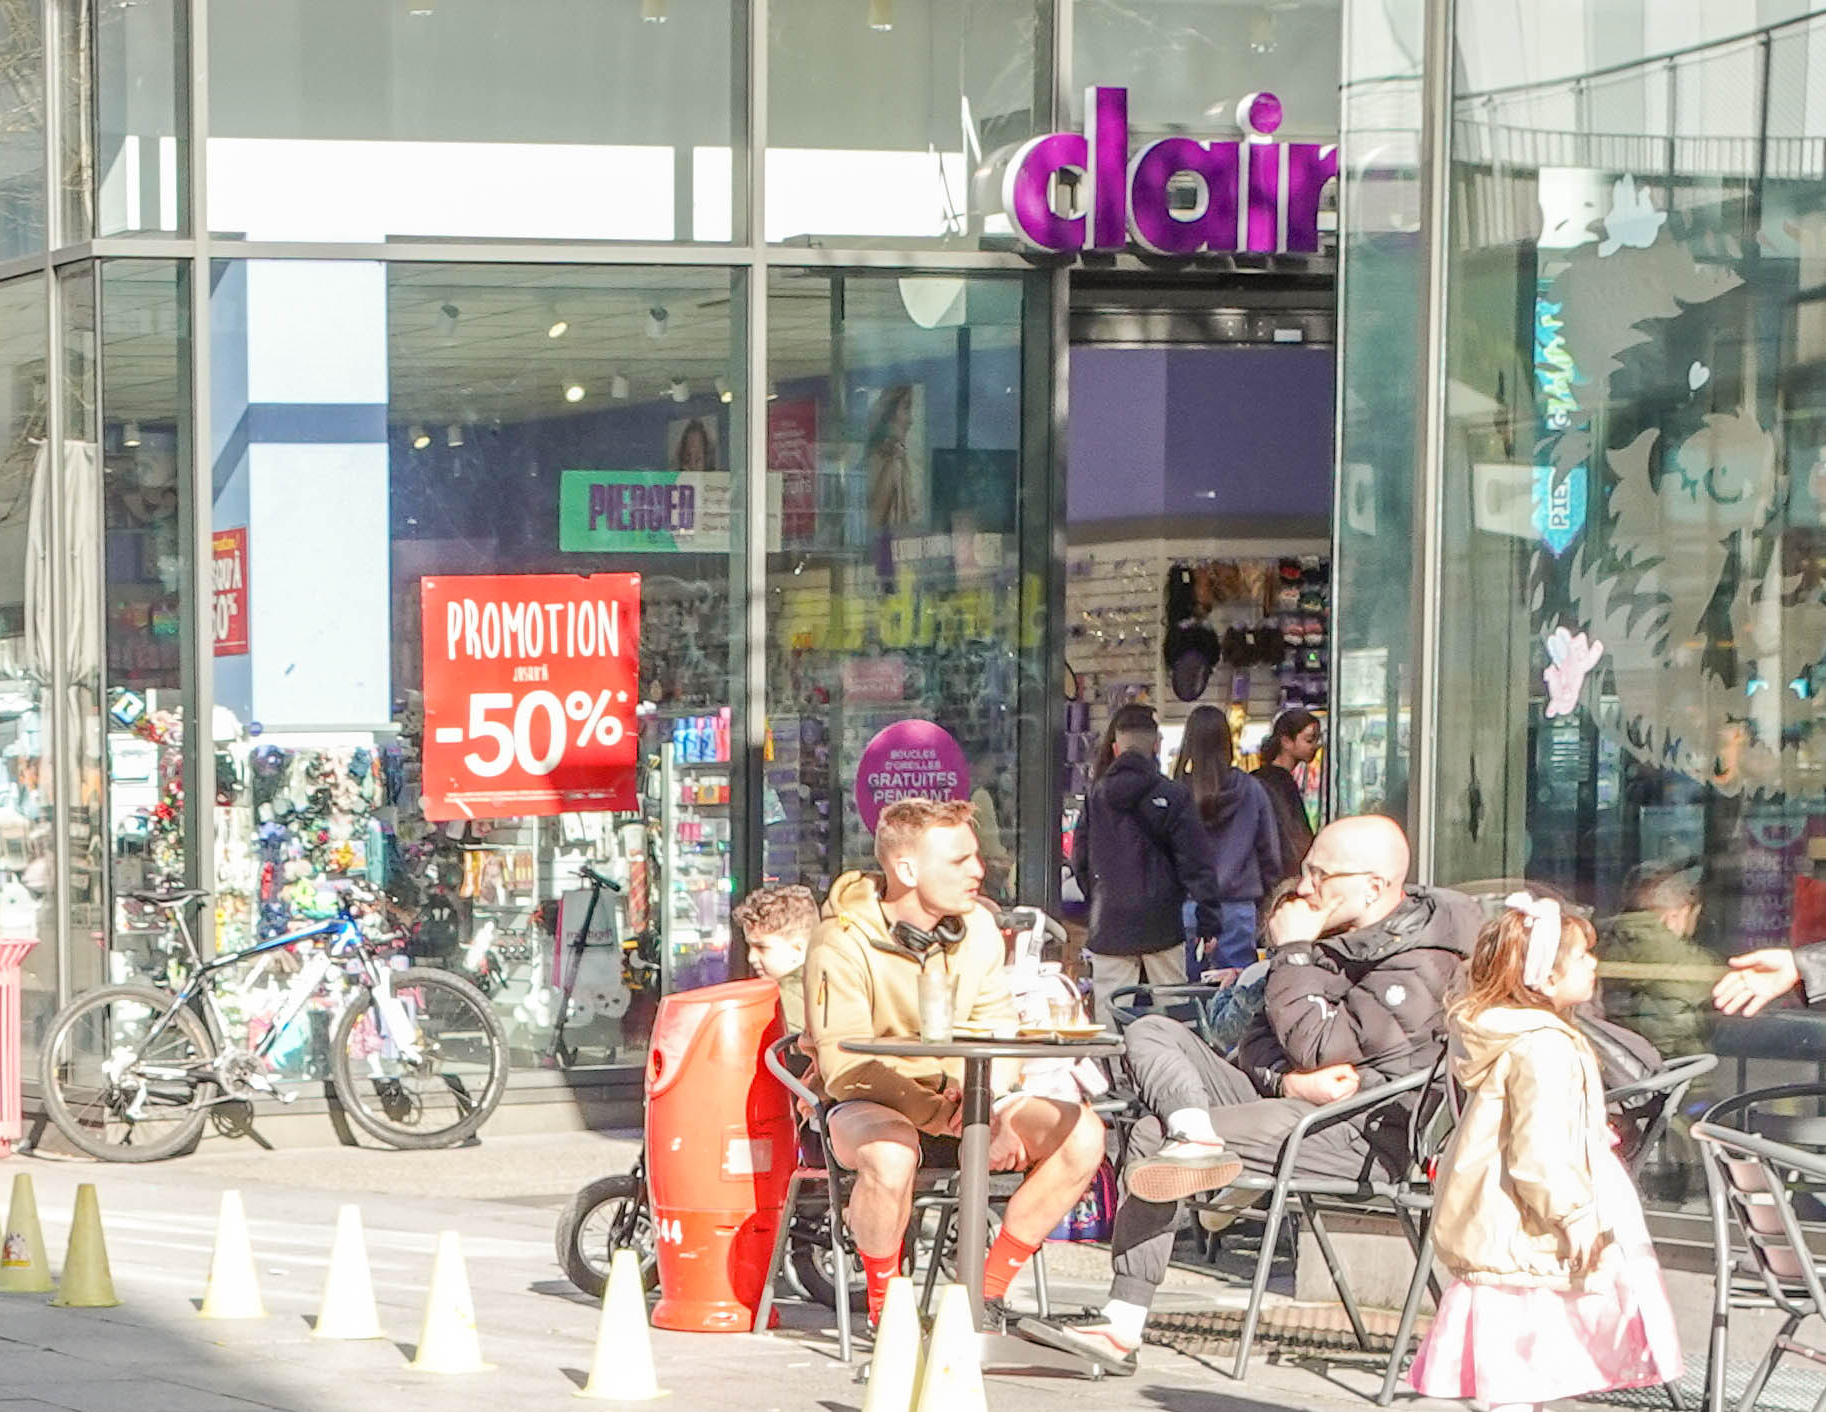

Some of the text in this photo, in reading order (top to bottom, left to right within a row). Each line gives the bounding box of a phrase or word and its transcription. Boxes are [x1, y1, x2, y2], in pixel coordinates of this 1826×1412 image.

[446, 598, 620, 661] PROMOTION
[867, 771, 958, 788] GRATUITES
[872, 788, 953, 805] PENDANT
